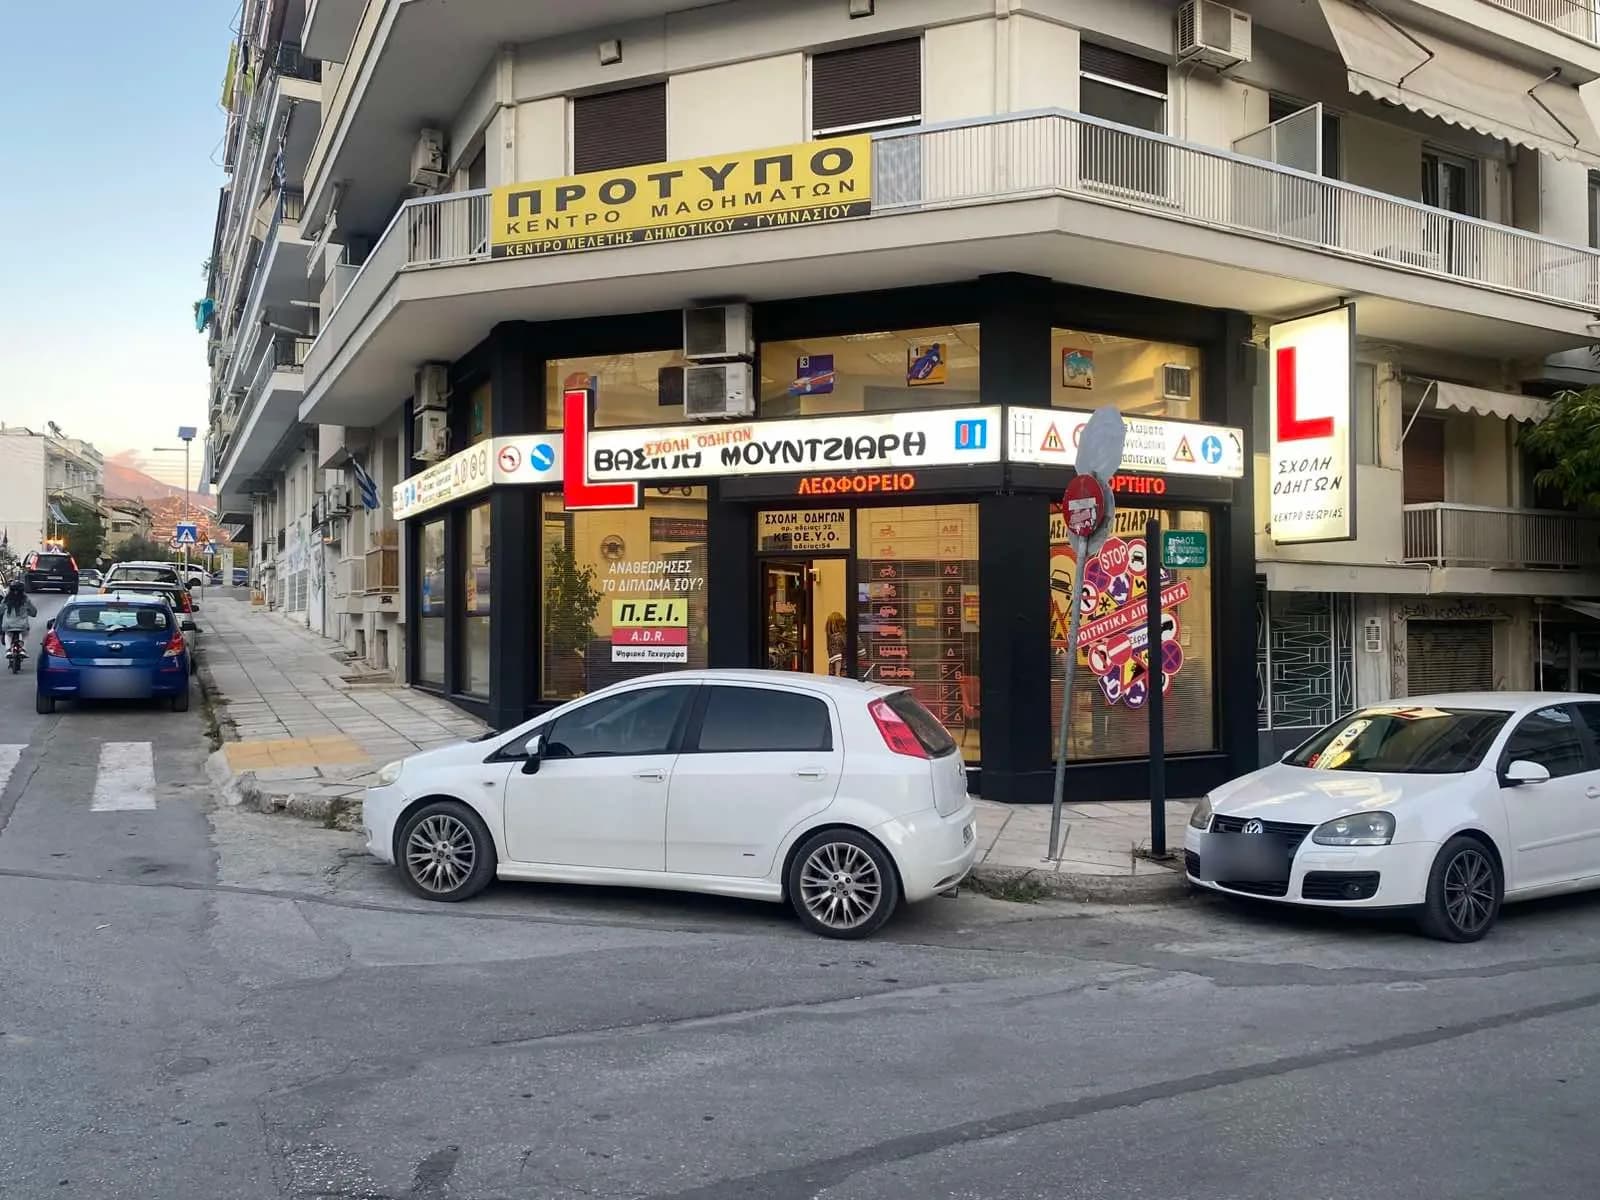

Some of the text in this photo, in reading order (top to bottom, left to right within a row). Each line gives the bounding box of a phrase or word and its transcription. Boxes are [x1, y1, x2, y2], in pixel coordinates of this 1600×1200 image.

[508, 147, 854, 217] ΠΡΟΤΥΠΟ
[507, 178, 854, 234] ΚΕΝΤΡΟ ΜΑΘΗΜΑΤΩΝ
[506, 238, 562, 256] ΚΕΝΤΡΟ
[567, 231, 634, 249] ΜΕΛΕΤΗΣ
[644, 218, 735, 240] ΔΗΜΟΤΙΚΟΥ
[757, 204, 852, 227] ΓΥΜΝΑΣΙΟΥ
[1277, 346, 1334, 442] L
[564, 390, 637, 509] L
[644, 428, 752, 456] ΣΧΟΛΗ ΟΔΗΓΩΝ
[721, 431, 926, 467] ΜΟΥΝΤΖΙΑΡΗ
[1279, 456, 1332, 474] ΣΧΟΛΗ
[798, 474, 915, 494] ΛΕΩΦΟΡΕΙΟ
[1273, 476, 1342, 495] ΟΔΗΓΩΝ
[765, 512, 845, 524] ΣΧΟΛΗ ΟΔΗΓΩΝ
[1274, 507, 1343, 522] ΚΕΝΤΡΟ ΘΕΩΡΙΑΣ
[608, 560, 692, 574] ΑΝΑΘΕΩΡΗΣΕΣ
[1101, 548, 1127, 570] STOP
[603, 579, 616, 592] ΤΟ
[619, 579, 671, 592] ΔΙΠΛΩΜΑ
[620, 603, 679, 622] Π.Ε.Ι.
[630, 631, 665, 642] A.D.R.
